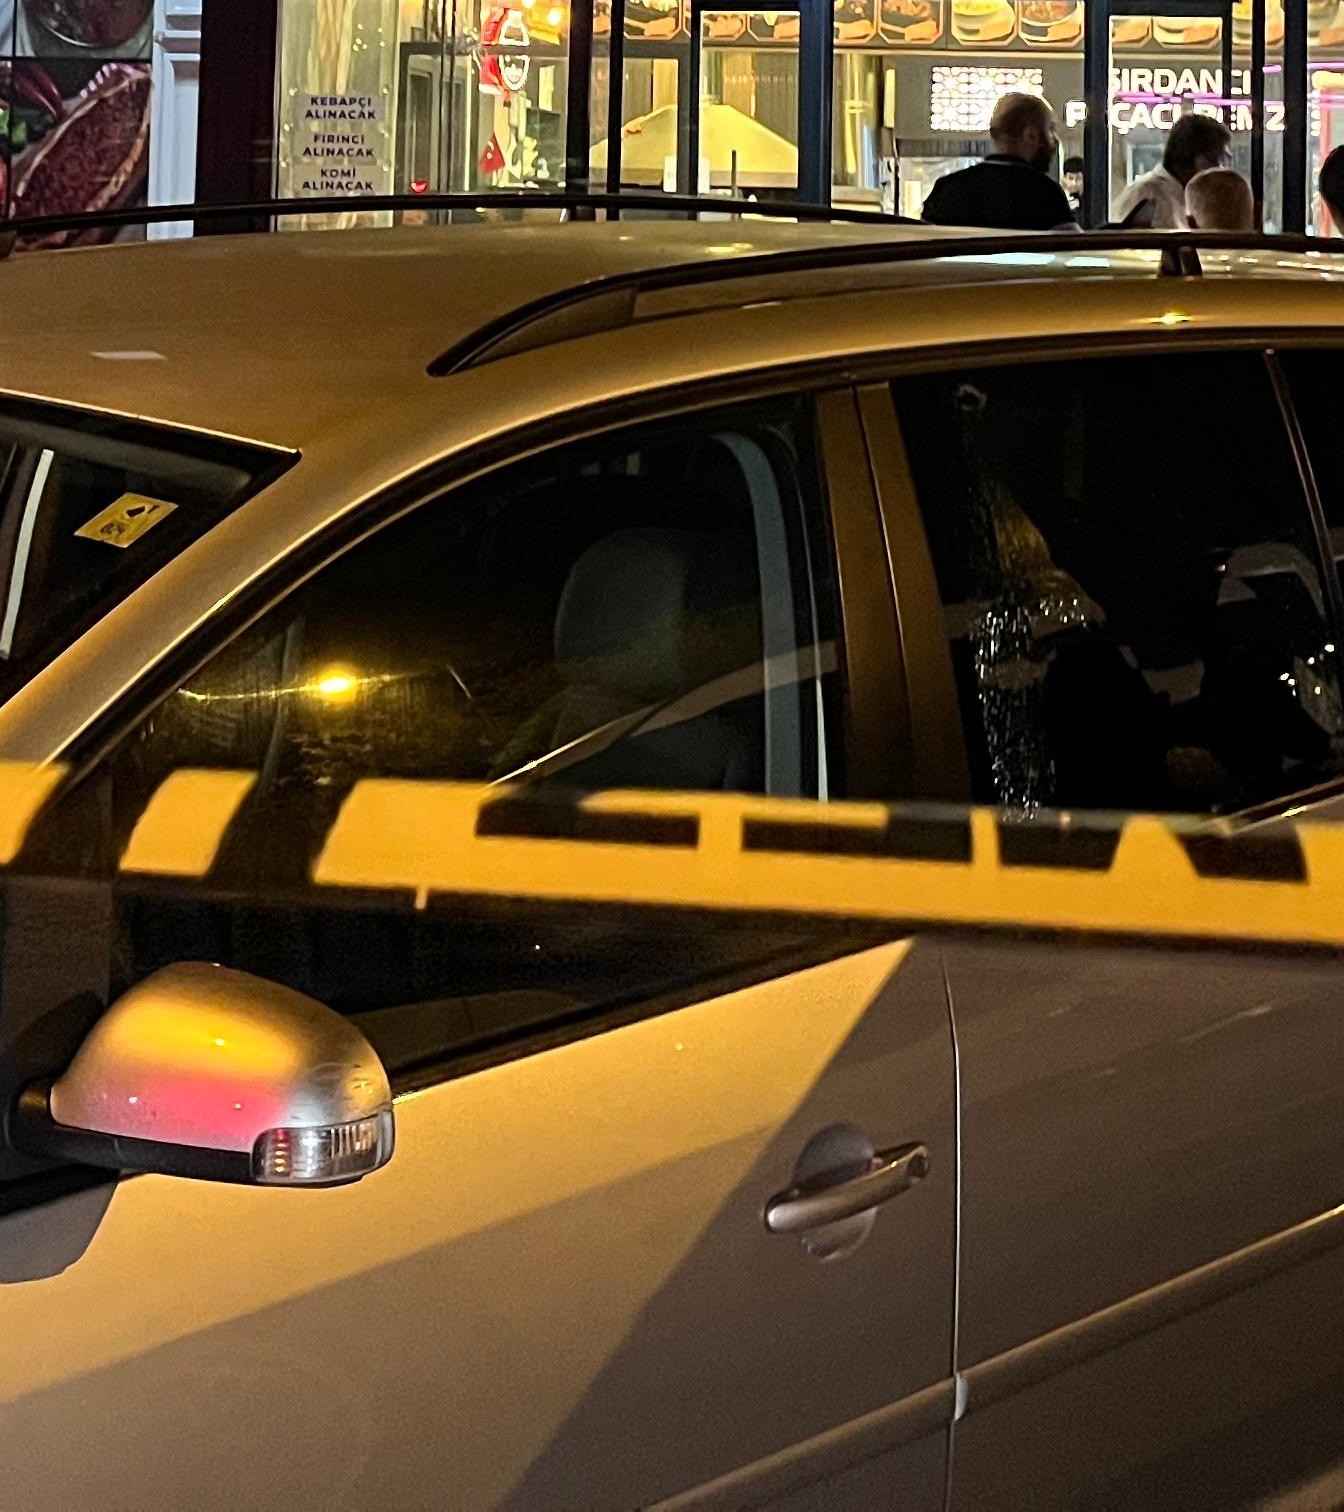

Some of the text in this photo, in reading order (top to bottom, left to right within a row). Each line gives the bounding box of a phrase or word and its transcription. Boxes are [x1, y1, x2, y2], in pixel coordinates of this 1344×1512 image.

[310, 97, 372, 108] KEBAPÇI
[305, 109, 376, 120] ALINACAK
[313, 134, 365, 144] FIRINCI
[302, 147, 375, 157] ALINACAK
[302, 181, 374, 191] ALINACAK
